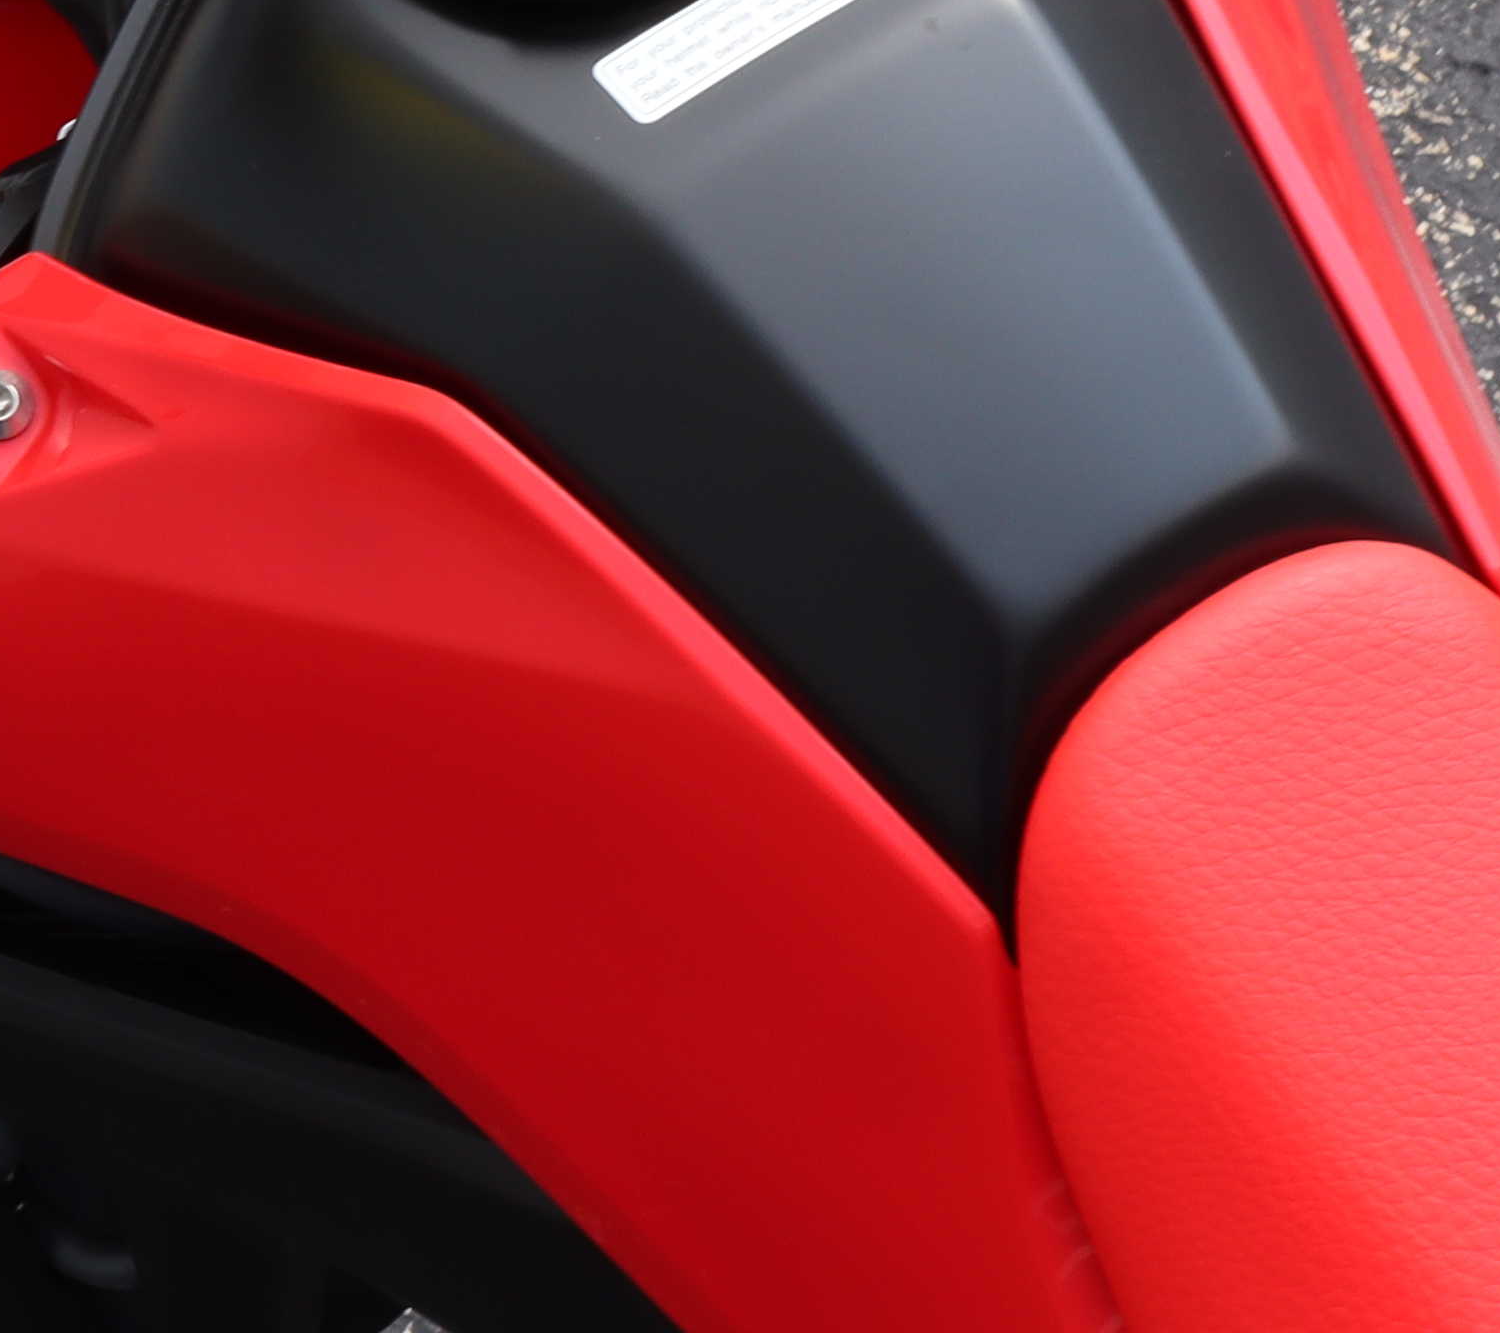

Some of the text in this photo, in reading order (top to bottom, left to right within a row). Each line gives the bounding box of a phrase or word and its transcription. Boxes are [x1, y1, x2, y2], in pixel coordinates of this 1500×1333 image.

[614, 57, 640, 76] For
[646, 34, 677, 58] your
[629, 68, 660, 92] your
[663, 35, 712, 67] helmet
[716, 11, 752, 34] while
[640, 77, 680, 103] Read
[683, 60, 709, 77] the
[713, 25, 766, 59] owner's
